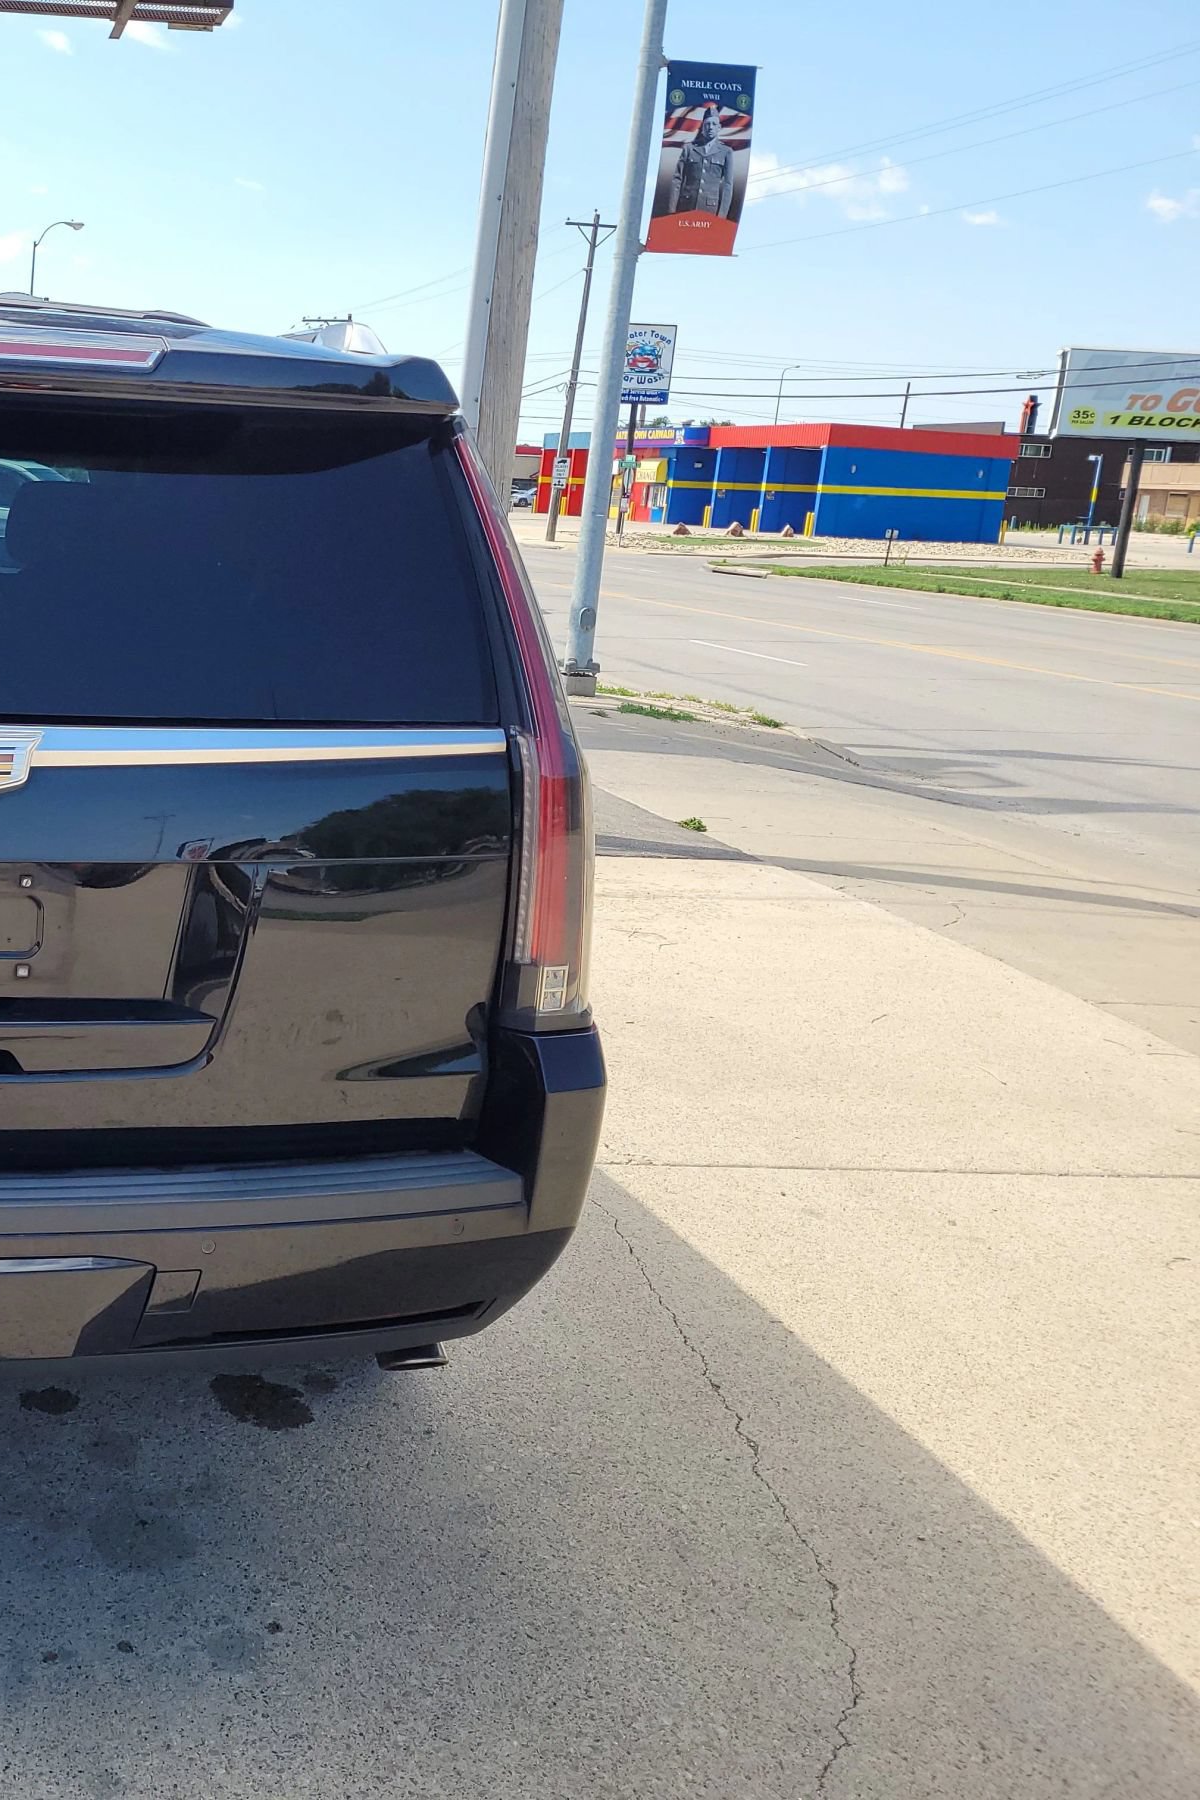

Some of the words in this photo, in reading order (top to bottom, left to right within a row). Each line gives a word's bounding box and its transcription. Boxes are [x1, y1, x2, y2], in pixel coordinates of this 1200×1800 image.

[681, 79, 712, 89] MERLE
[713, 82, 742, 91] COATS
[629, 331, 647, 339] ater
[650, 330, 672, 345] Town
[623, 375, 635, 383] ar
[1125, 394, 1162, 411] TO
[1166, 388, 1200, 414] G
[1109, 415, 1122, 425] 1
